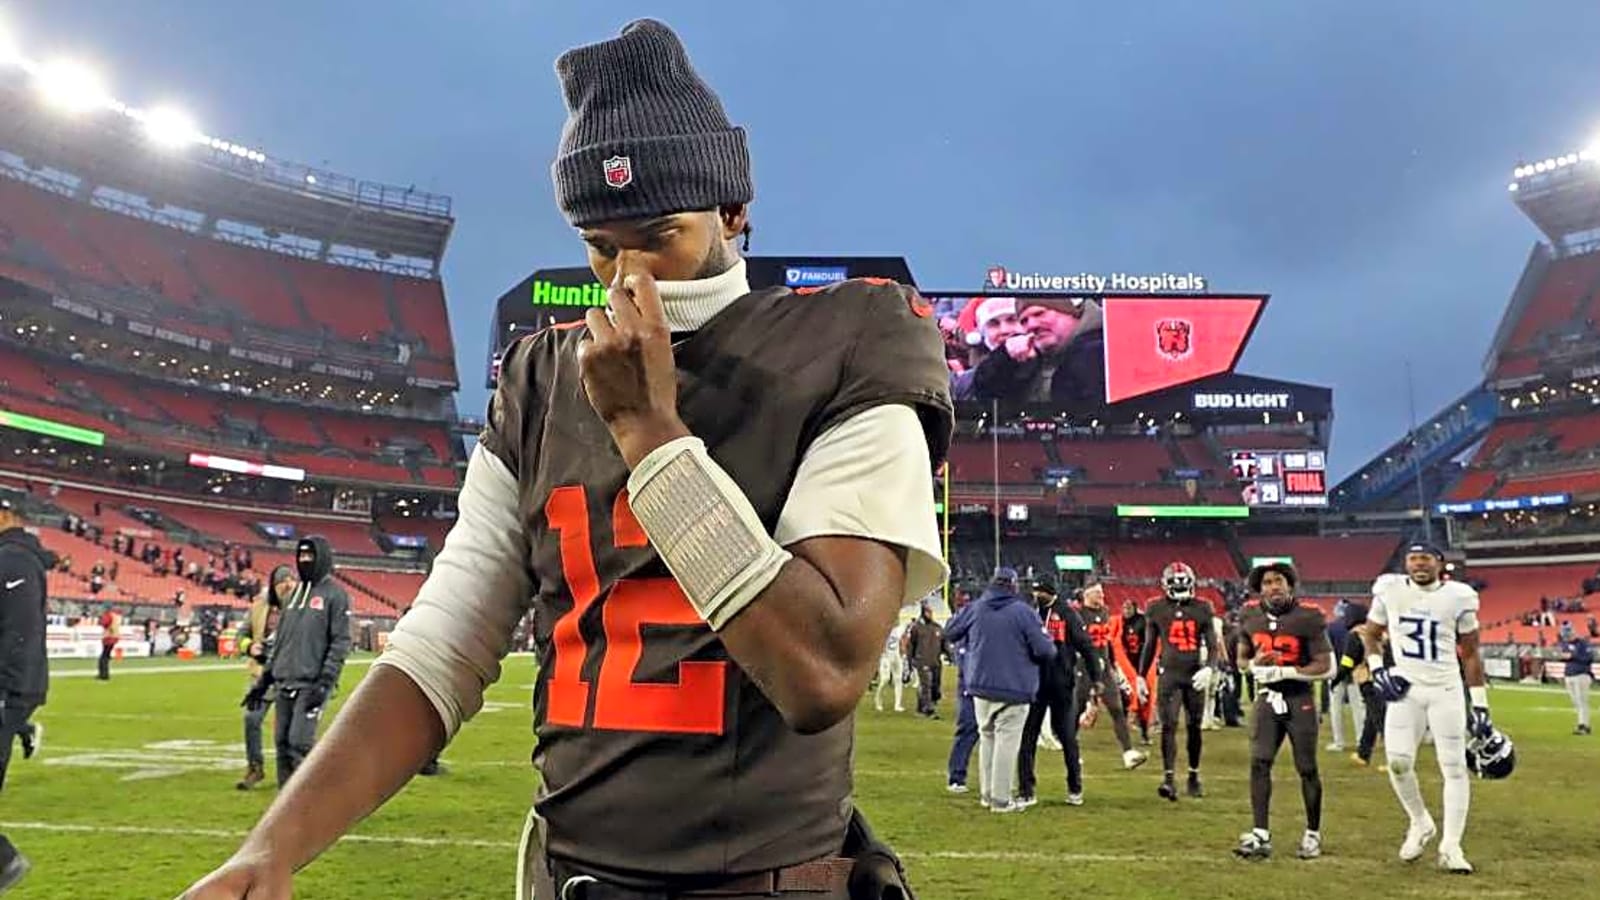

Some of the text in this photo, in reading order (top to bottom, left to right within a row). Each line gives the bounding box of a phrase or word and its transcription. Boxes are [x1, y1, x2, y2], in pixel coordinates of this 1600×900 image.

[1006, 272, 1204, 293] University Hospitals
[1195, 393, 1289, 408] BUD LIGHT
[1286, 472, 1324, 492] FINAL
[544, 484, 727, 736] 12
[1168, 619, 1197, 651] 41
[1399, 615, 1440, 660] 31
